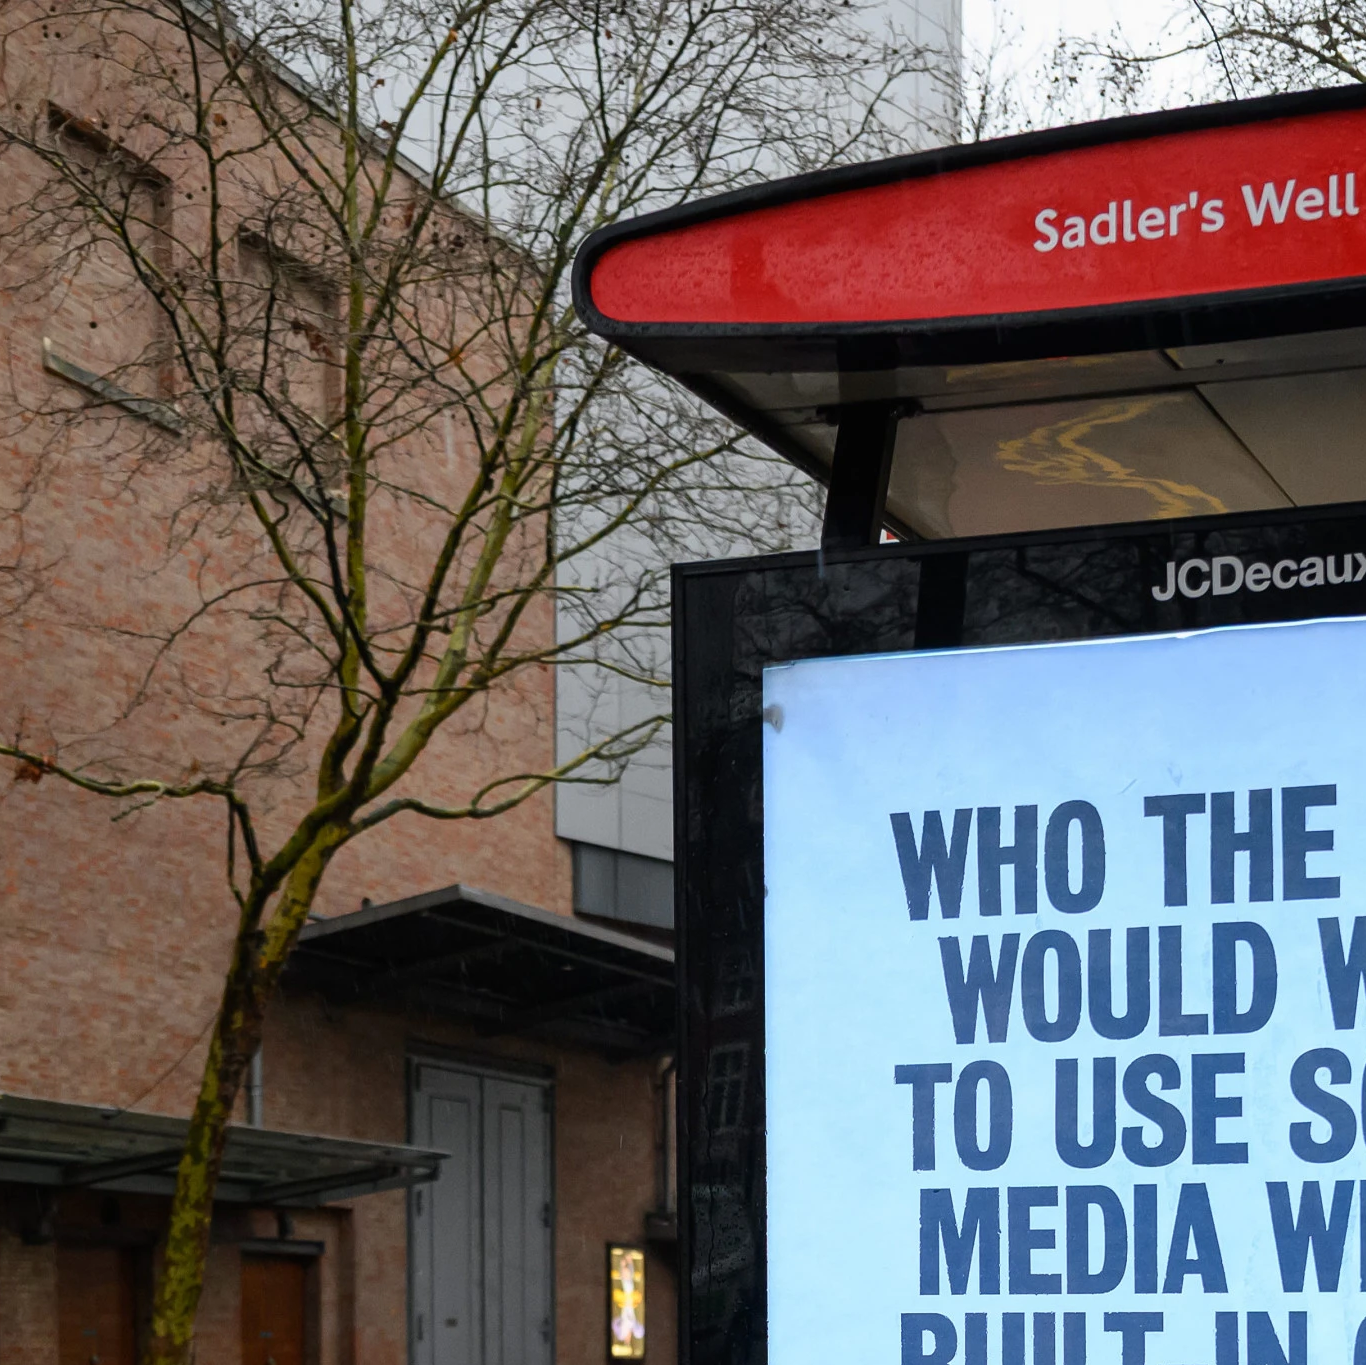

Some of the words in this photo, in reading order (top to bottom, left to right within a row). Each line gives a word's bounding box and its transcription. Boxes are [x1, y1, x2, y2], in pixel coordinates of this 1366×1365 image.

[1033, 190, 1226, 253] Sadler's
[1241, 171, 1361, 227] Well
[889, 799, 1108, 922] WHO
[1143, 783, 1341, 908] THE
[937, 920, 1279, 1046] WOULD
[893, 1058, 1014, 1173] TO
[1053, 1051, 1250, 1169] USE
[918, 1182, 1229, 1297] MEDIA
